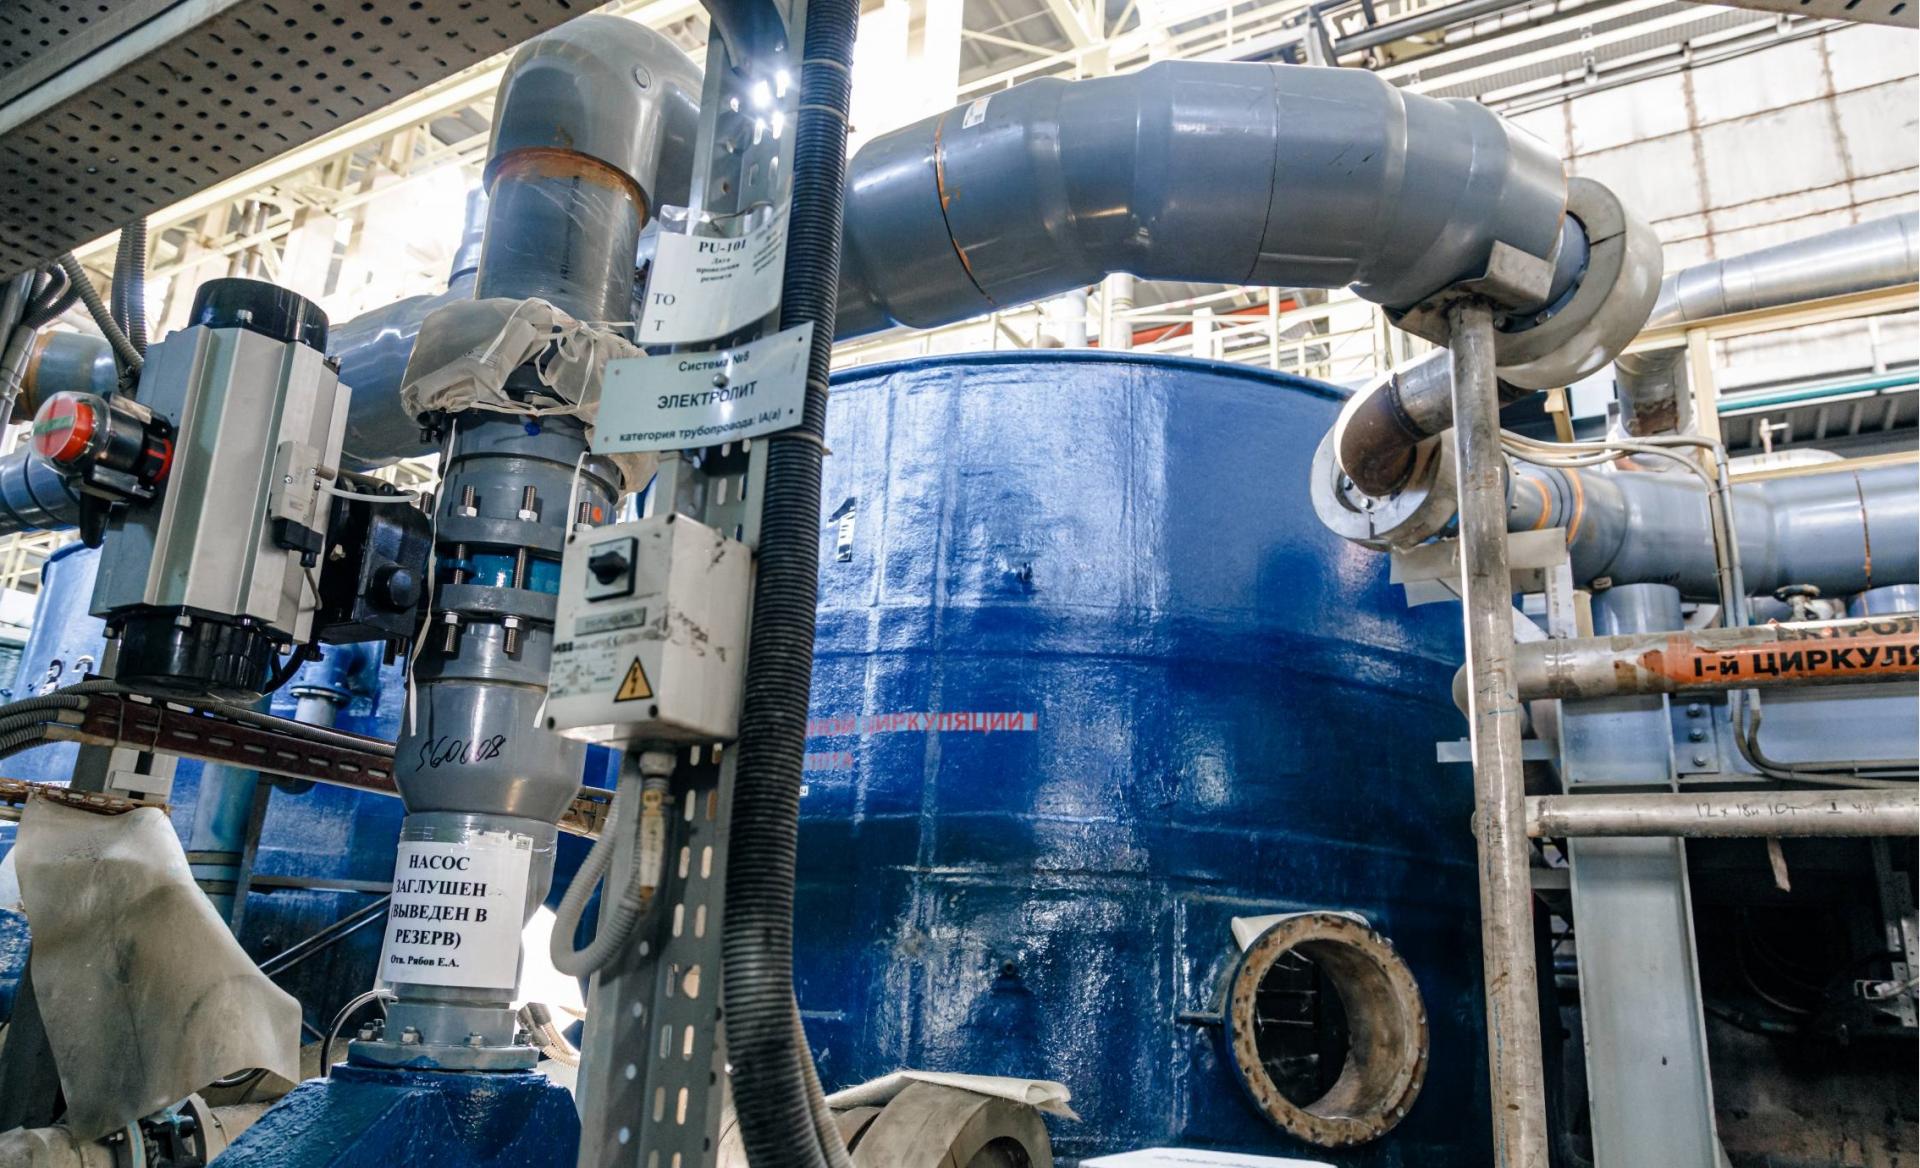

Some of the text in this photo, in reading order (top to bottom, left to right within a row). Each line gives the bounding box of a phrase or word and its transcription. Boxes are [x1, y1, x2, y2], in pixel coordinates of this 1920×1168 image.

[698, 239, 747, 254] PU-101
[678, 358, 729, 372] Система
[657, 380, 758, 409] ЭЛЕКТРОЛИТ
[619, 430, 675, 443] категория
[679, 416, 756, 439] трубопровода:
[408, 854, 471, 871] НАСОС
[396, 879, 489, 898] ЗАГЛУШЕН
[390, 904, 488, 923] (ВЫВЕДЕН В
[395, 928, 462, 950] РЕЗЕРВ)
[390, 954, 460, 968] Отв. Рябов Е.А.
